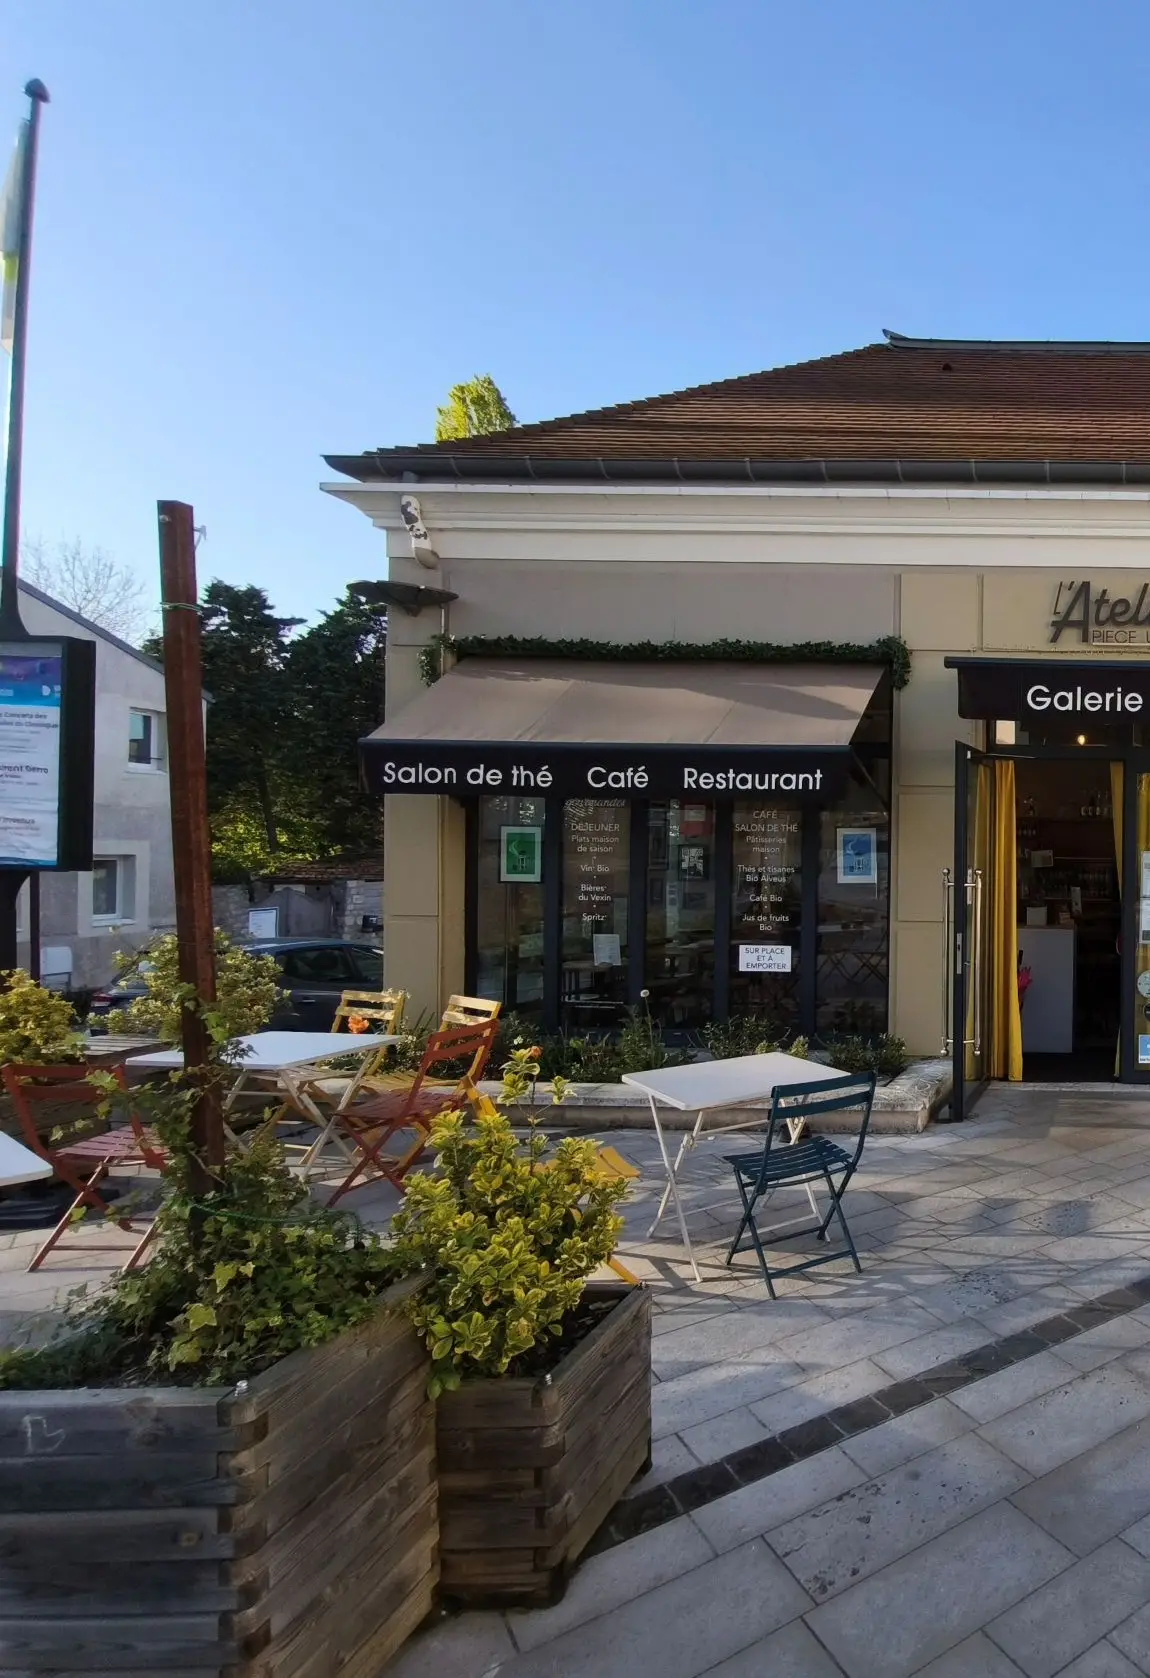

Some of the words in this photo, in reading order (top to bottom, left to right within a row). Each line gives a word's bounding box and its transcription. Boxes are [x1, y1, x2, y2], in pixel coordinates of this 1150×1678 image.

[1092, 630, 1137, 643] PIECE
[1026, 685, 1143, 712] Galerie
[383, 762, 457, 784] Salon
[466, 764, 503, 786] de
[511, 765, 553, 788] thé
[587, 765, 649, 788] Café
[683, 767, 823, 790] Restaurant
[735, 823, 765, 832] SALON
[767, 824, 778, 832] DE
[571, 834, 590, 843] Plats
[577, 844, 587, 852] de
[589, 845, 613, 853] saison
[597, 863, 610, 872] Bio
[746, 874, 758, 882] Bio
[578, 893, 588, 901] du
[749, 893, 768, 902] Café
[770, 894, 783, 902] Bio
[742, 913, 755, 922] Jus
[757, 914, 767, 922] de
[769, 913, 790, 922] fruits
[759, 923, 772, 931] Bio
[761, 947, 785, 955] PLACE
[746, 962, 787, 970] EMPORTER
